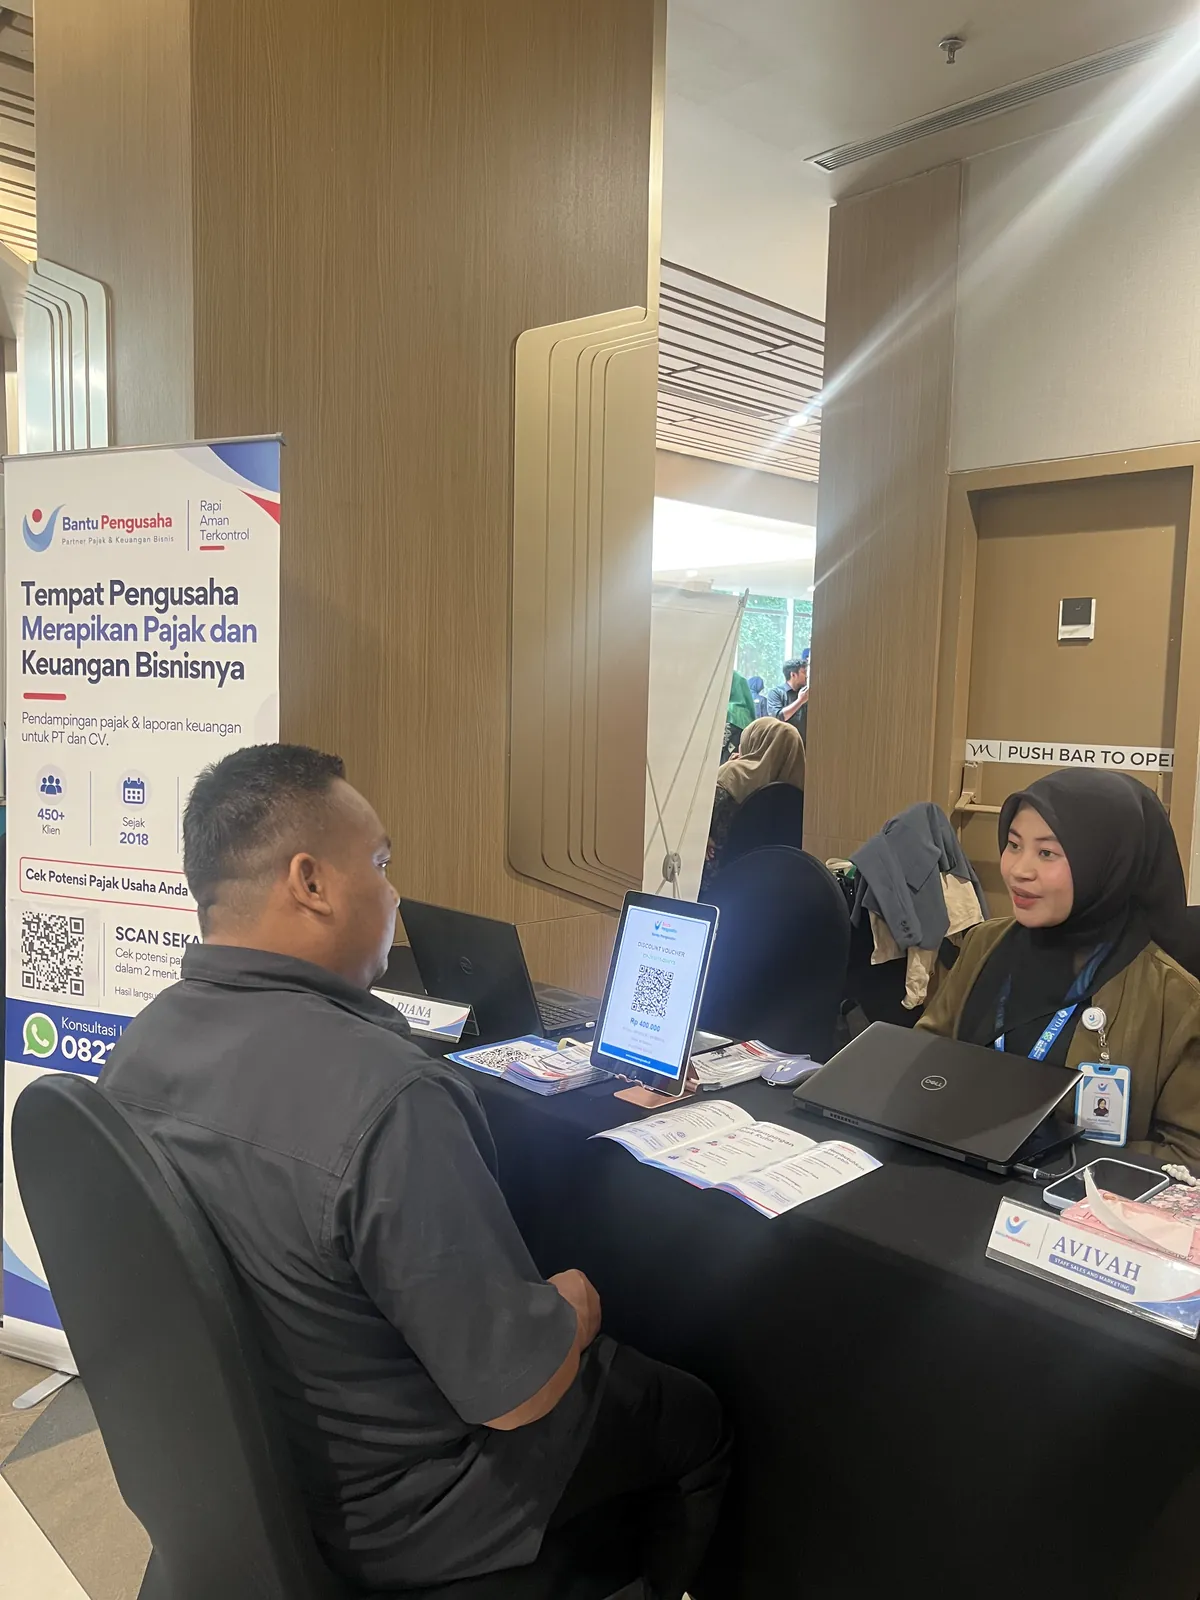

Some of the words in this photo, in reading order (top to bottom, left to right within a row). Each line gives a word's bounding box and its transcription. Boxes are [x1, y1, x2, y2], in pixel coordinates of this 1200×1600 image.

[200, 500, 222, 514] Rapi
[62, 516, 99, 532] Bantu
[101, 513, 173, 534] Pengusaha
[200, 515, 229, 526] Aman
[62, 538, 86, 546] Partner
[88, 537, 106, 546] Pajak
[115, 536, 151, 546] Keuangan
[153, 535, 174, 543] Bisnis
[200, 528, 250, 541] Terkontrol
[21, 581, 104, 614] Tempat
[109, 577, 239, 614] Pengusaha
[22, 615, 138, 649] Merapikan
[143, 615, 206, 651] Pajak
[210, 615, 257, 643] dan
[22, 650, 130, 685] Keuangan
[136, 651, 245, 688] Bisnisnya
[22, 712, 98, 730] Pendampingan
[100, 715, 129, 732] pajak
[131, 716, 140, 728] &
[143, 716, 184, 733] laporan
[185, 718, 242, 737] keuangan
[22, 731, 49, 743] untuk
[51, 731, 65, 744] PT
[67, 732, 86, 745] dan
[89, 733, 109, 746] CV.
[1008, 745, 1053, 760] PUSH
[1059, 748, 1096, 763] BAR
[1101, 751, 1125, 765] TO
[37, 808, 65, 821] 450+
[41, 825, 61, 836] Klien
[122, 816, 146, 830] Sejak
[119, 832, 149, 846] 2018
[26, 868, 46, 882] Cek
[49, 870, 87, 886] Potensi
[89, 875, 119, 892] Pajak
[121, 877, 156, 893] Usaha
[158, 881, 188, 896] Anda
[115, 926, 159, 945] SCAN
[115, 947, 134, 959] Cek
[135, 950, 168, 963] potensi
[637, 941, 661, 952] DISCOUNT
[662, 947, 686, 958] VOUCHER
[115, 963, 142, 976] dalam
[144, 966, 151, 977] 2
[152, 969, 180, 980] menit.
[114, 986, 132, 997] Hasil
[396, 1002, 432, 1018] DIANA
[61, 1016, 116, 1037] Konsultasi
[630, 1017, 638, 1027] Rp
[924, 1078, 943, 1088] DELL
[1052, 1236, 1142, 1282] AVIVAH
[1054, 1257, 1069, 1268] STAFF
[1070, 1263, 1086, 1274] SALES
[1087, 1270, 1099, 1279] AND
[1100, 1275, 1130, 1291] MARKETING
